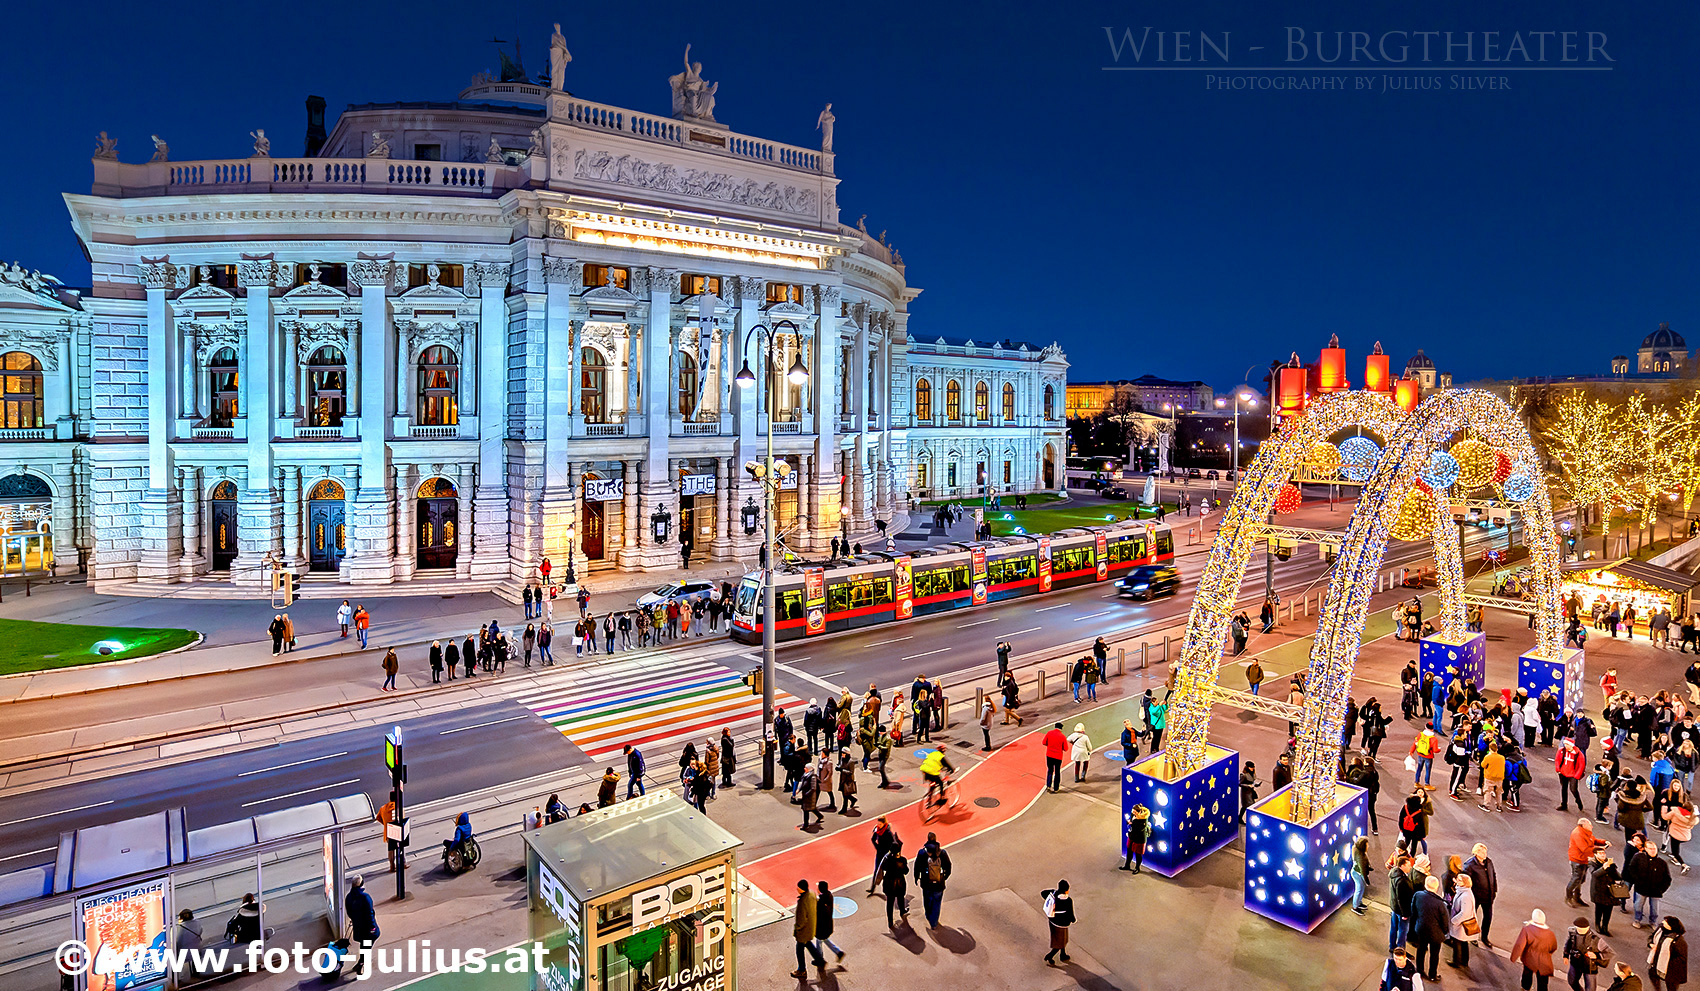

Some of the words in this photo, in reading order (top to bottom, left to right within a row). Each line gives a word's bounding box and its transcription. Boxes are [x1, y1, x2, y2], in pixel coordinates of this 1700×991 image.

[84, 884, 164, 910] BURGTHEATER
[128, 894, 162, 908] FROH
[632, 864, 727, 928] BOE
[632, 896, 727, 935] PARKING
[703, 919, 727, 960] P
[568, 948, 581, 986] P
[657, 954, 725, 991] ZUGANG
